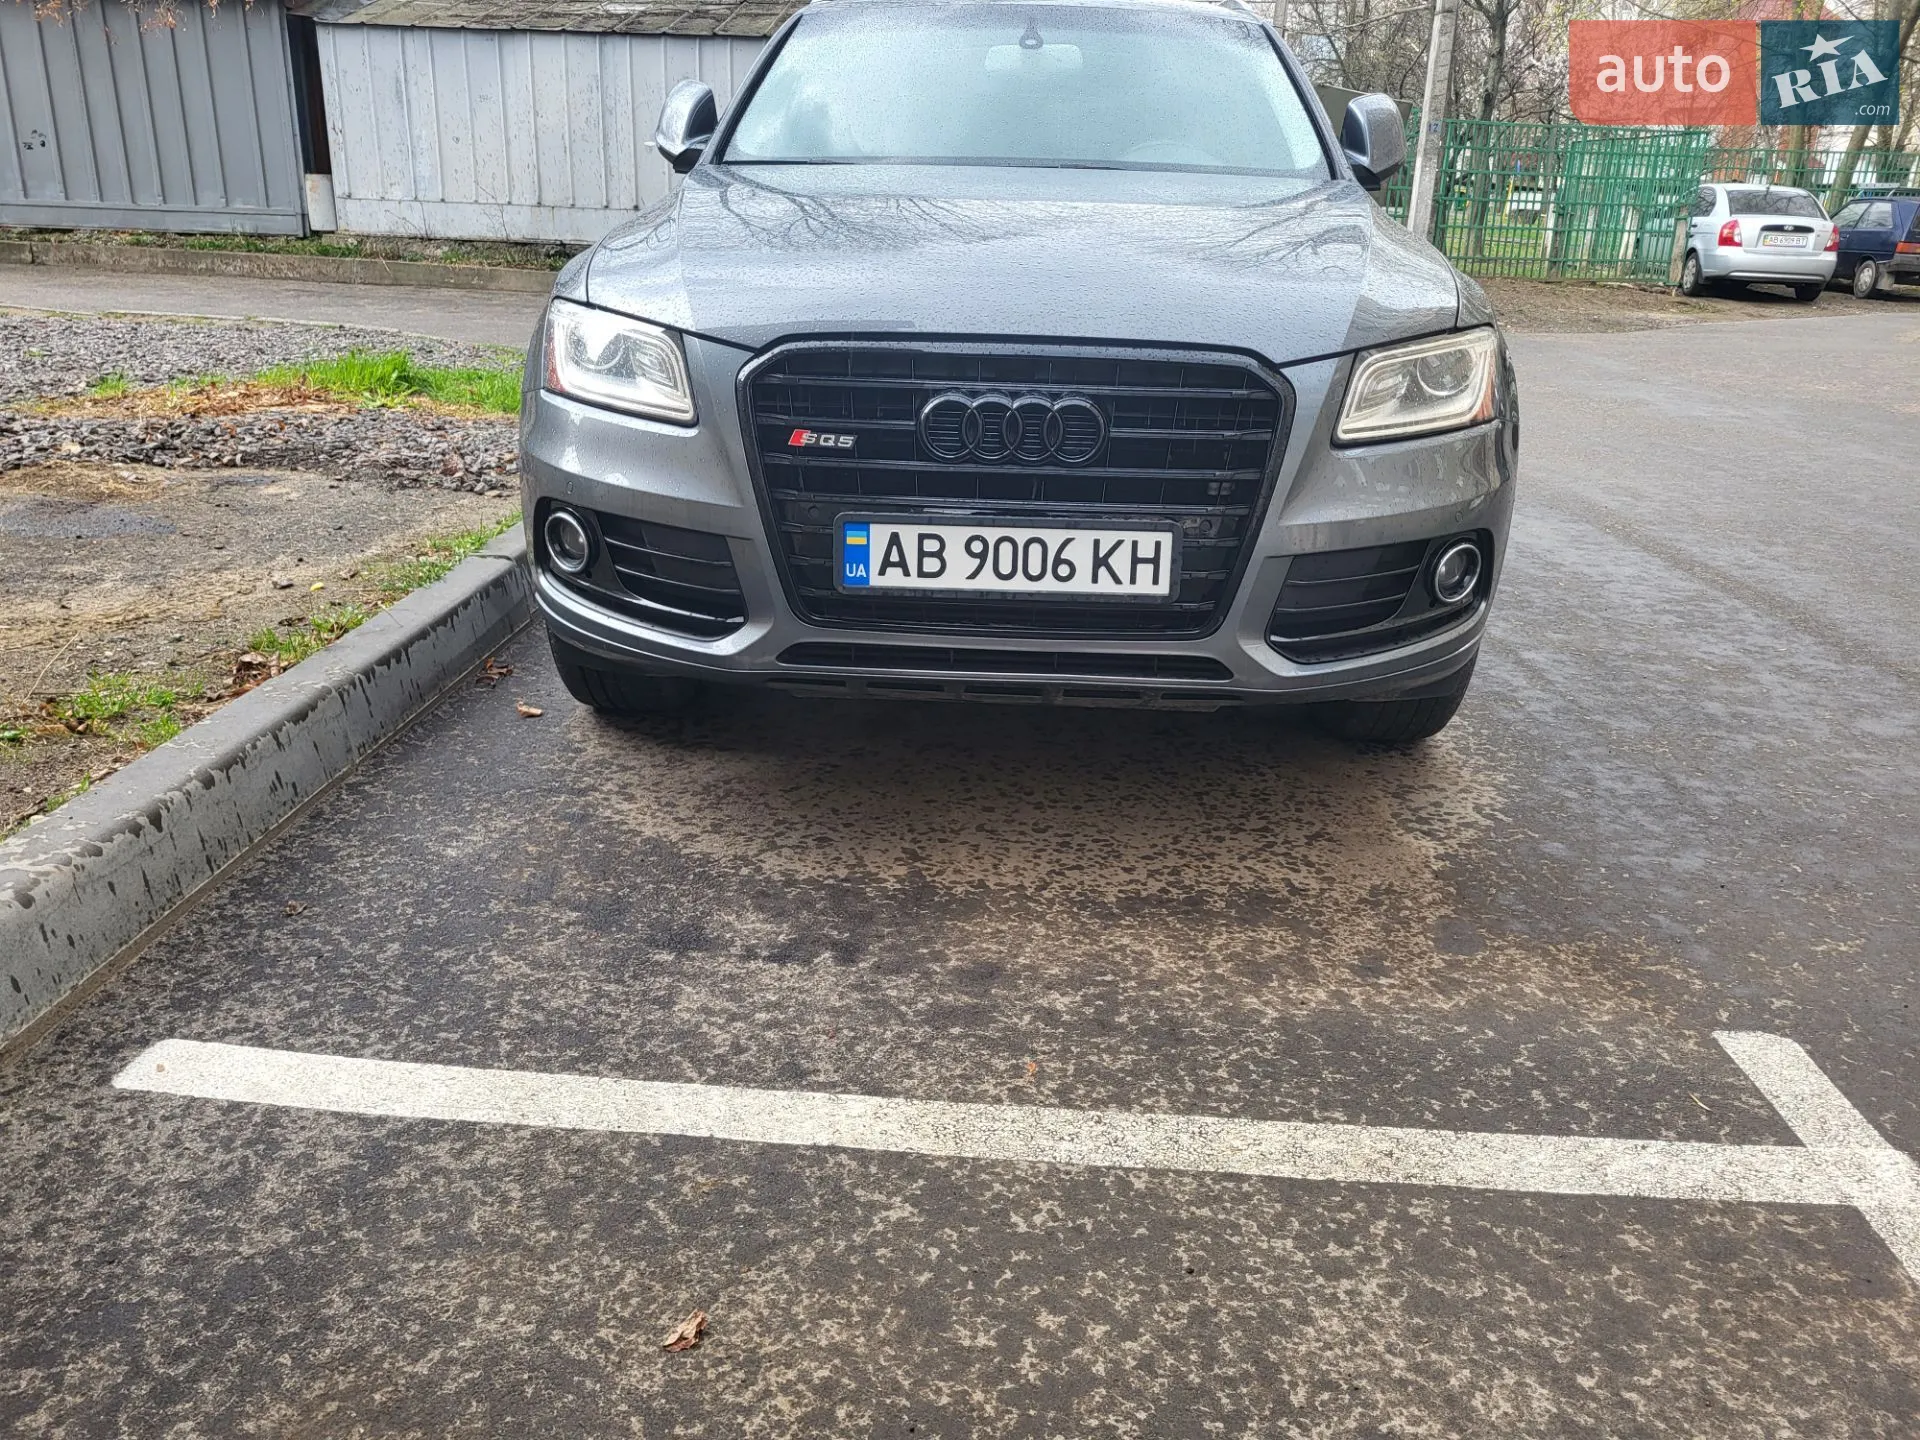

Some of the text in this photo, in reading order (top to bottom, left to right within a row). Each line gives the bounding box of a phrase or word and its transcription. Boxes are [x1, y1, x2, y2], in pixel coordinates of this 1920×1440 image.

[800, 432, 854, 448] SQ5
[878, 531, 1162, 586] AB 9006 KH
[846, 563, 867, 578] UA
